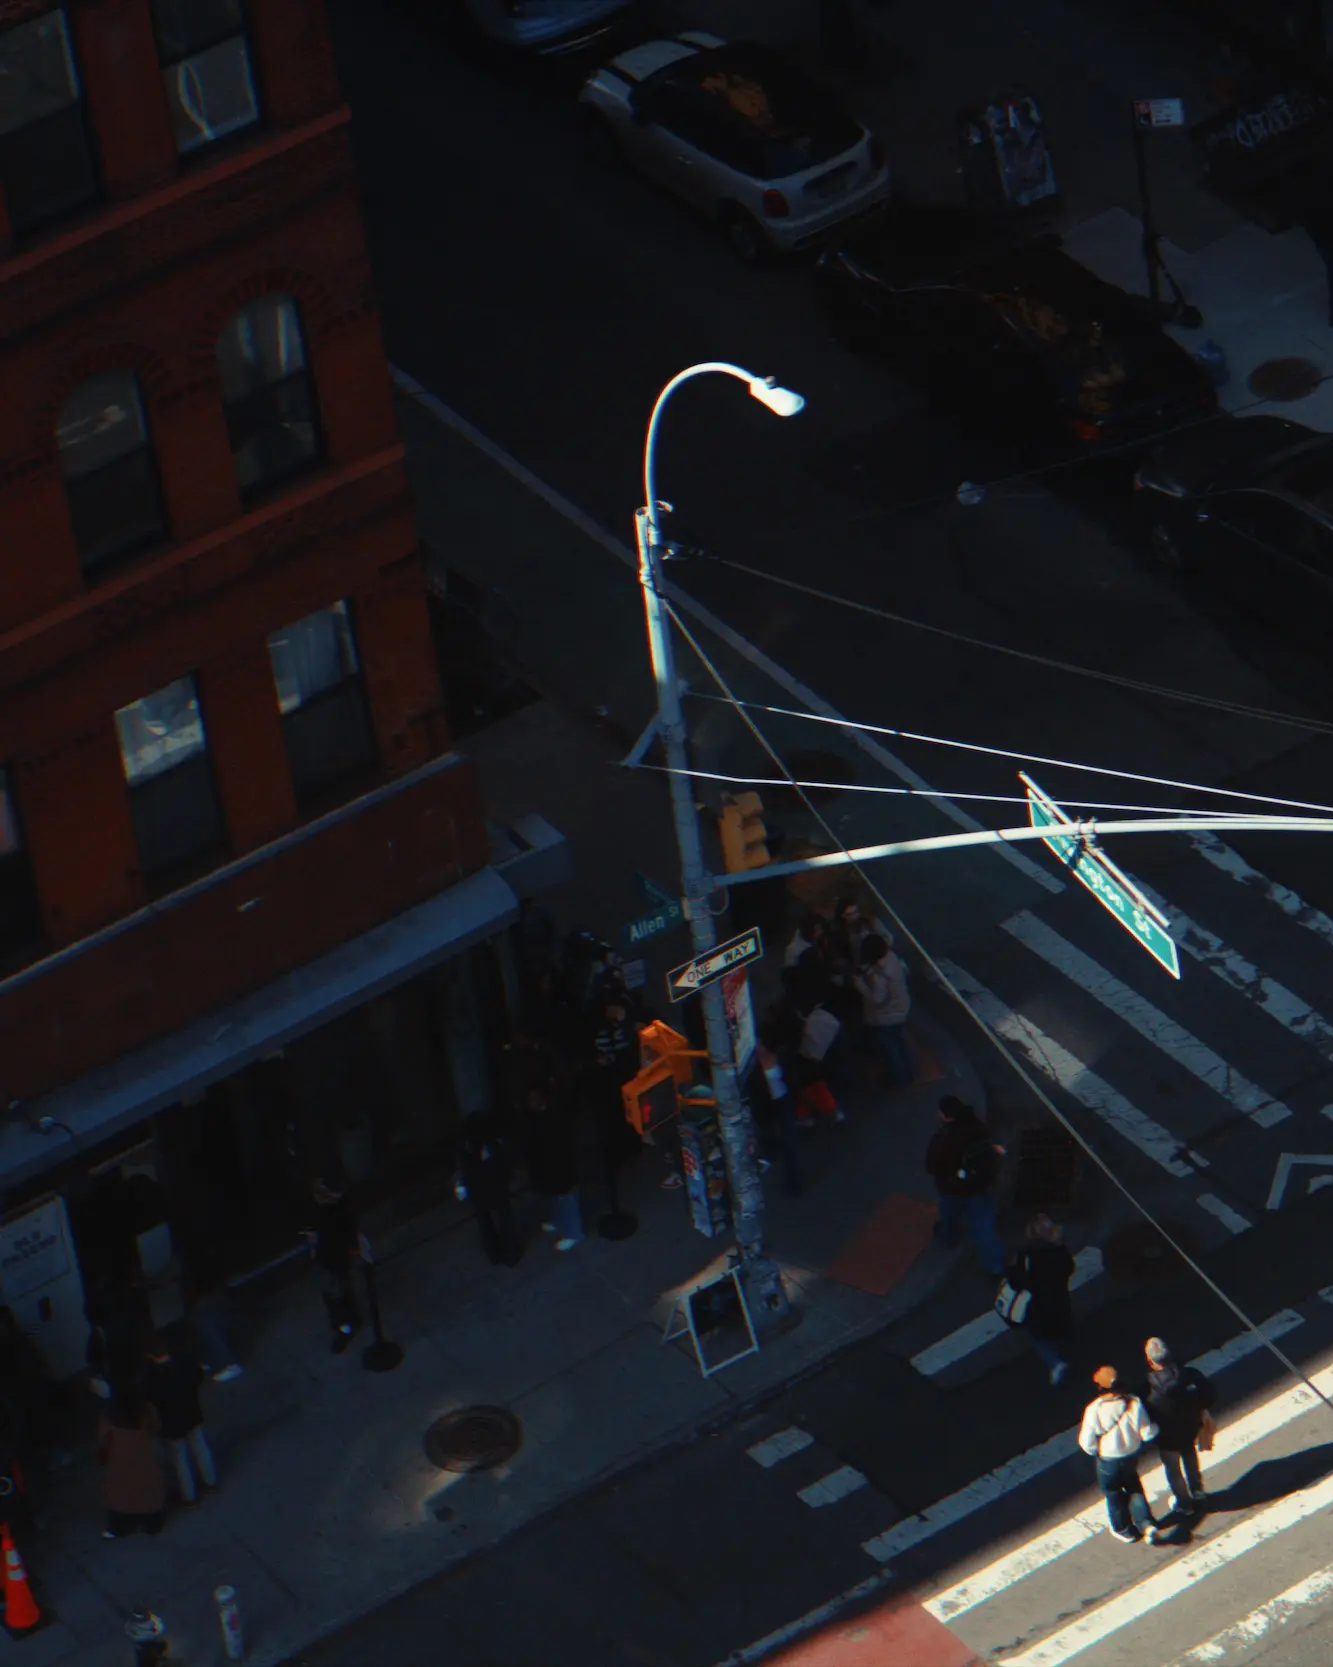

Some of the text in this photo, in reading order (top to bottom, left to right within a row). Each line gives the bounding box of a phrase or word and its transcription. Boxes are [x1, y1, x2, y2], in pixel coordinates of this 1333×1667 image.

[629, 915, 666, 943] Allen
[1132, 909, 1152, 941] St
[687, 941, 750, 983] ONE WAY
